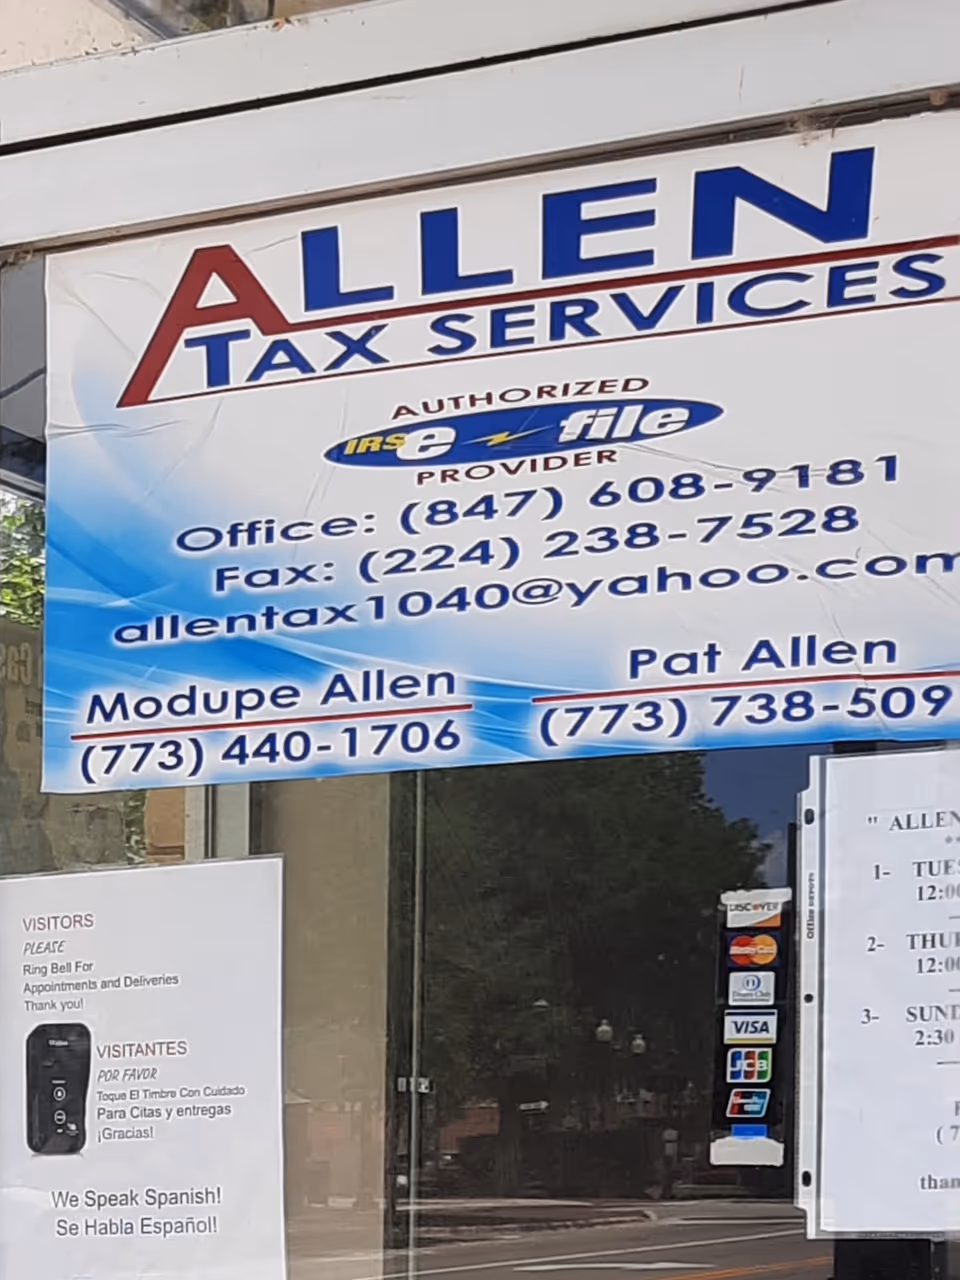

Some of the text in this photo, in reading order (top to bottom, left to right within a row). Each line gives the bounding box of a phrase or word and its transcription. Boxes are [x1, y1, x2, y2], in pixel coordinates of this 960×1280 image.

[118, 146, 876, 408] ALLEN
[184, 252, 947, 389] TAX SERVICES
[391, 377, 651, 420] AUTHORIZED
[343, 432, 406, 457] IRS
[558, 403, 690, 444] file
[416, 449, 618, 485] PROVIDER
[175, 454, 899, 555] Office: (847) 608-9181
[215, 505, 859, 595] Fax: (224) 238-7528
[114, 548, 960, 646] allentax1040@yahoo.com
[628, 634, 897, 680] Pat Allen
[88, 668, 456, 725] Modupe Allen
[540, 685, 953, 746] (773) 738-509
[80, 718, 462, 784] (773) 440-1706
[873, 864, 890, 880] 1-
[23, 914, 94, 932] VISITORS
[24, 940, 65, 956] PLEASE
[867, 936, 885, 951] 2-
[24, 960, 93, 977] Ring Bell For
[24, 974, 179, 995] Appointments and Deliveries
[25, 998, 84, 1012] Thank you!
[861, 1008, 879, 1024] 3-
[733, 1020, 770, 1034] VISA
[914, 1029, 954, 1046] 2:30
[97, 1042, 188, 1060] VISITANTES
[730, 1058, 768, 1071] JCB
[98, 1068, 157, 1082] POR FAVOR
[97, 1085, 245, 1104] Toque El Timbre Con Cuidado
[97, 1104, 232, 1121] Para Citas y entregas
[98, 1126, 154, 1143] ¡Gracias!
[52, 1186, 222, 1209] We Speak Spanish!
[56, 1215, 218, 1238] Se Habla Español!
